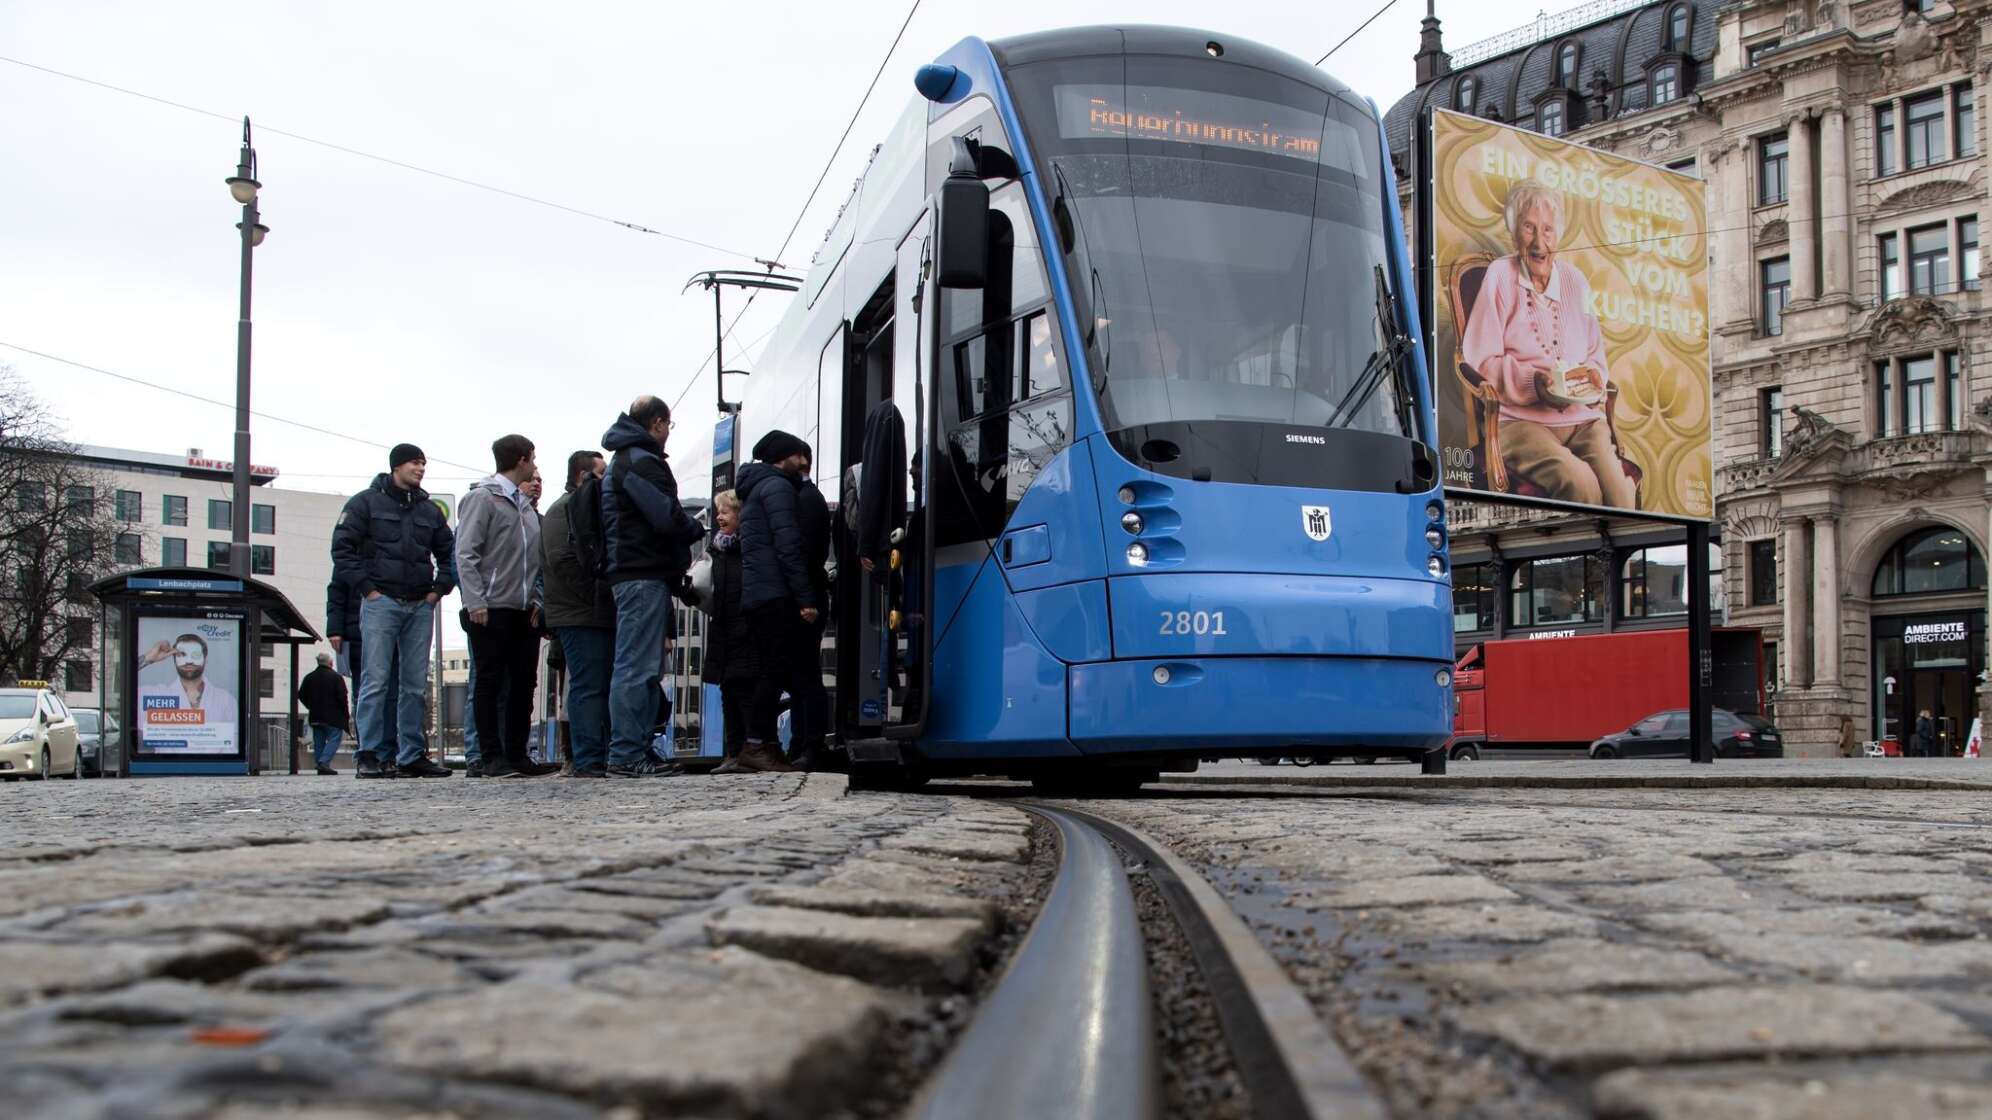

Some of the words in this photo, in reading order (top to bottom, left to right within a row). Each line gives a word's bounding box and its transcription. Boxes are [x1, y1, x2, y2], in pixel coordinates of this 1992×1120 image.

[1481, 144, 1529, 178] EIN
[1536, 160, 1688, 221] GRÖSSERES
[1606, 214, 1688, 261] STÜCK
[1625, 259, 1688, 297] VOM
[1583, 288, 1704, 337] KUCHEN?
[1285, 434, 1326, 445] SIEMENS
[188, 458, 213, 468] BAIN
[1444, 446, 1475, 469] 100
[1445, 470, 1474, 483] JAHRE
[1159, 610, 1227, 635] 2801
[1904, 622, 1965, 635] AMBIENTE
[147, 699, 176, 708] MEHR
[151, 711, 202, 722] GELASSEN
